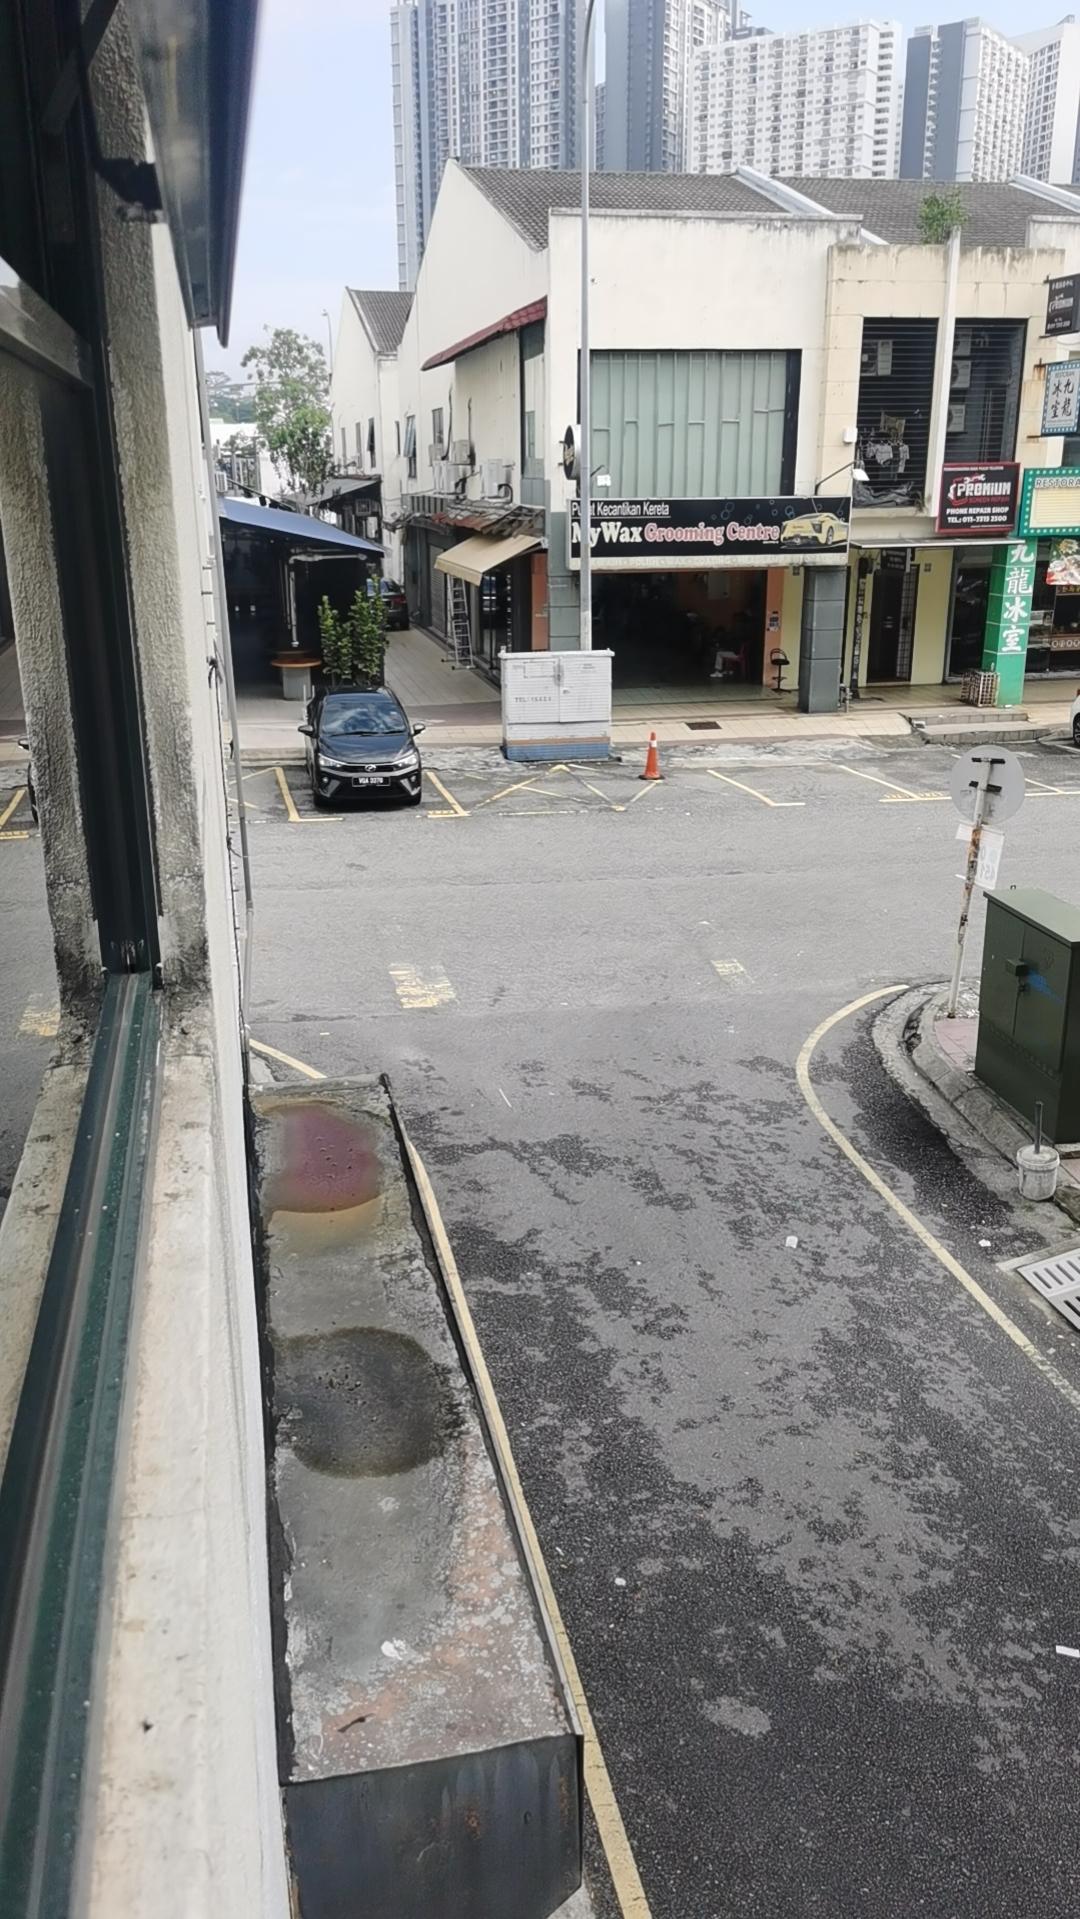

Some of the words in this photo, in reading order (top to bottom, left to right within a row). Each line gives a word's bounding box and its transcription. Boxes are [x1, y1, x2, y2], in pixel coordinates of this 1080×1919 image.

[596, 501, 641, 516] Kecantikan
[643, 501, 670, 516] Kereta
[992, 506, 1009, 514] SHOP
[644, 522, 725, 546] Grooming
[726, 521, 781, 541] Centre
[1001, 544, 1034, 652] 九龍冰室
